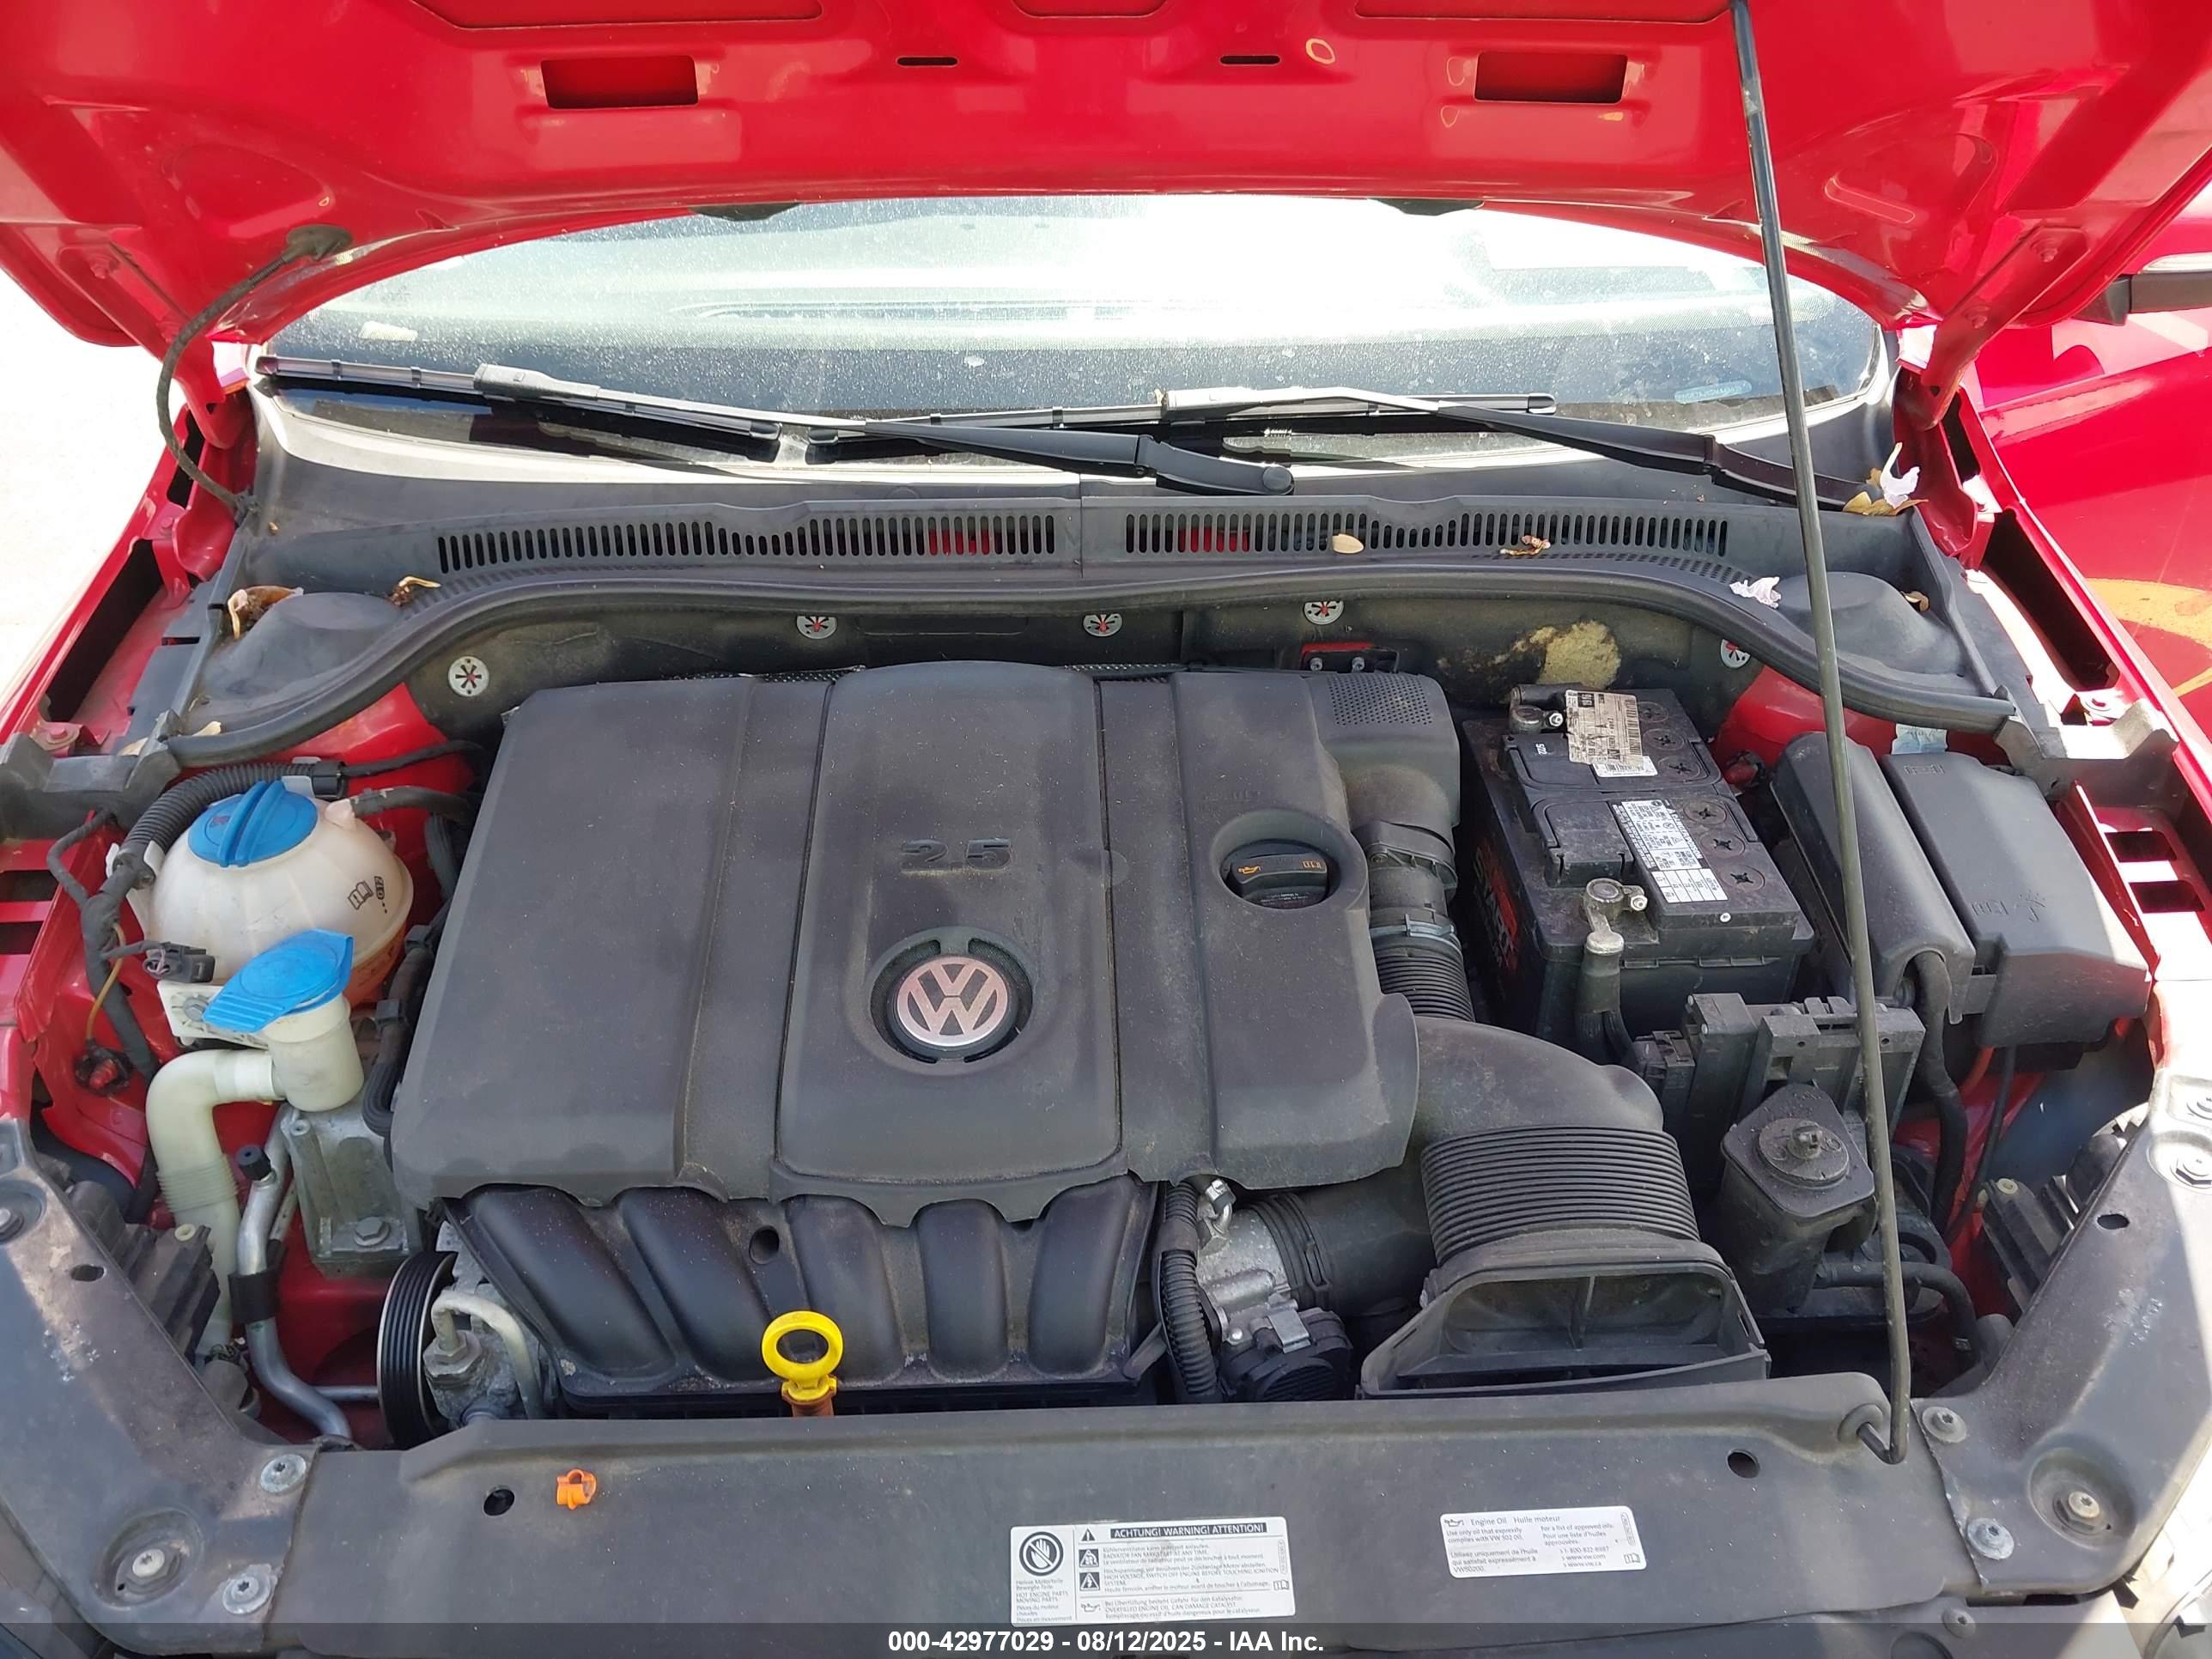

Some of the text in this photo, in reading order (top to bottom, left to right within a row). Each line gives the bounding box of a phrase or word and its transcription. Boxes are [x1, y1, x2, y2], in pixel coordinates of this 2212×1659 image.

[897, 957, 1007, 1047] VW
[1114, 1522, 1263, 1537] ACHTUNG! WARNING! ATTENTION!
